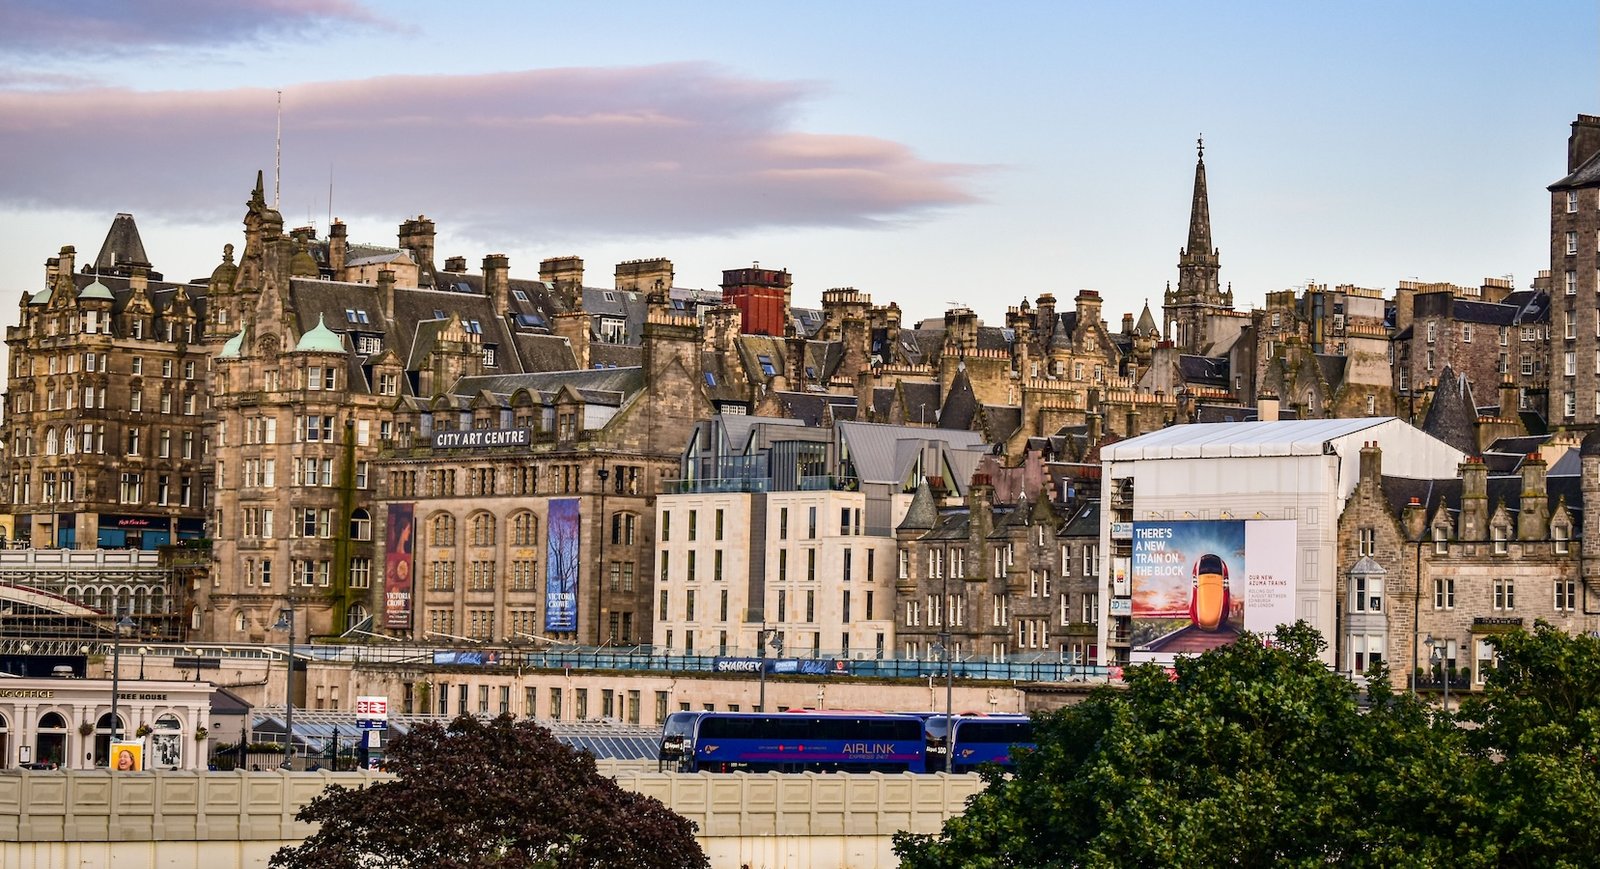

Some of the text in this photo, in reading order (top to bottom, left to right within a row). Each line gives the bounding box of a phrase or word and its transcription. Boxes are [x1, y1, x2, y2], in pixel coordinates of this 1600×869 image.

[437, 430, 525, 446] CITY ART CENTRE
[1135, 528, 1172, 539] THERE'S
[1135, 541, 1165, 551] A NEW
[1135, 553, 1178, 564] TRAIN ON
[1135, 565, 1153, 577] THE
[1154, 565, 1184, 576] BLOCK
[386, 592, 411, 600] VICTORIA
[548, 592, 576, 601] VICTORIA
[387, 599, 406, 607] CROWE
[548, 600, 570, 608] CROWE
[718, 660, 763, 672] SHARKEY
[15, 690, 54, 698] OFFICE
[842, 743, 895, 754] AIRLINK
[937, 746, 947, 754] 100
